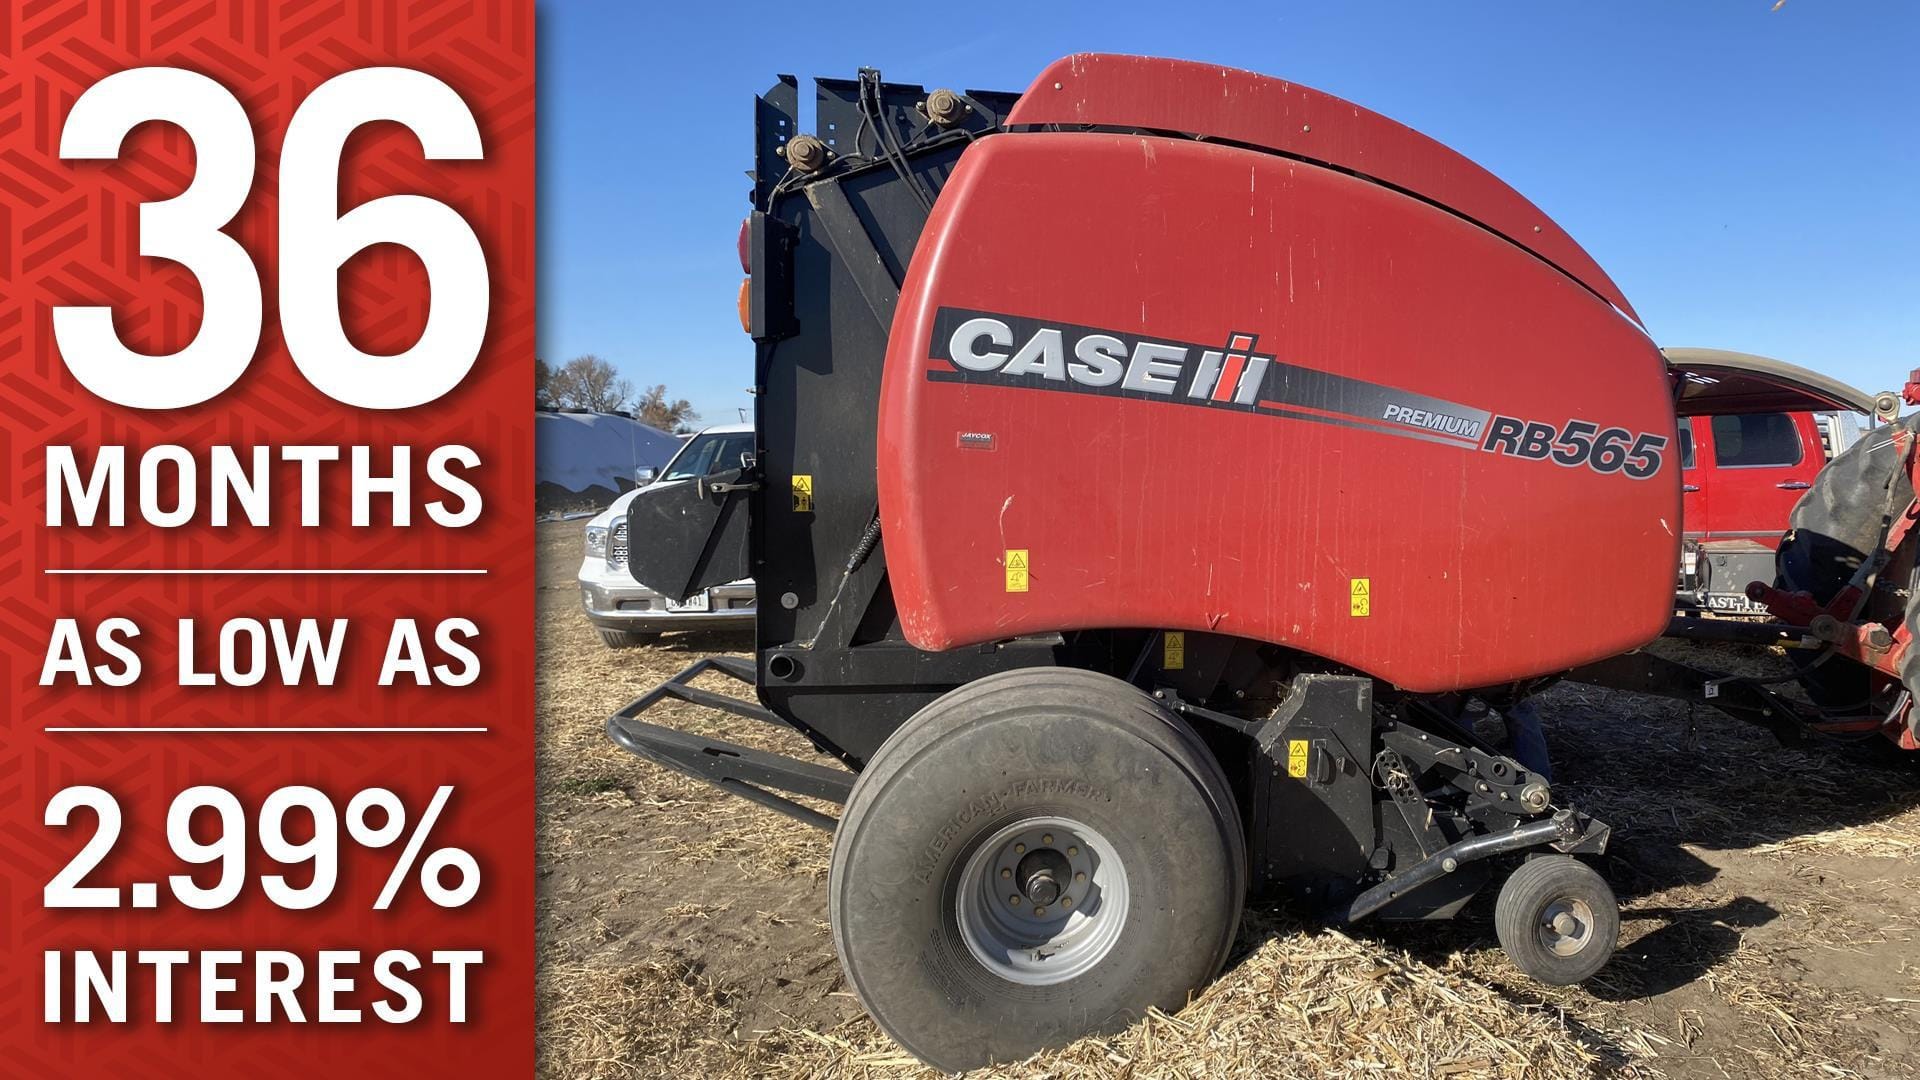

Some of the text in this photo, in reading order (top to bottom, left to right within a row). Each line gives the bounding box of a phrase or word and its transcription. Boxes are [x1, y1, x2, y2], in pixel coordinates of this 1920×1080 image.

[949, 317, 1189, 395] CASE
[961, 432, 993, 440] JAYCOX
[1382, 403, 1481, 438] PREMIUM
[1482, 414, 1669, 481] RB565
[913, 778, 1108, 885] AMERICAN FARMER
